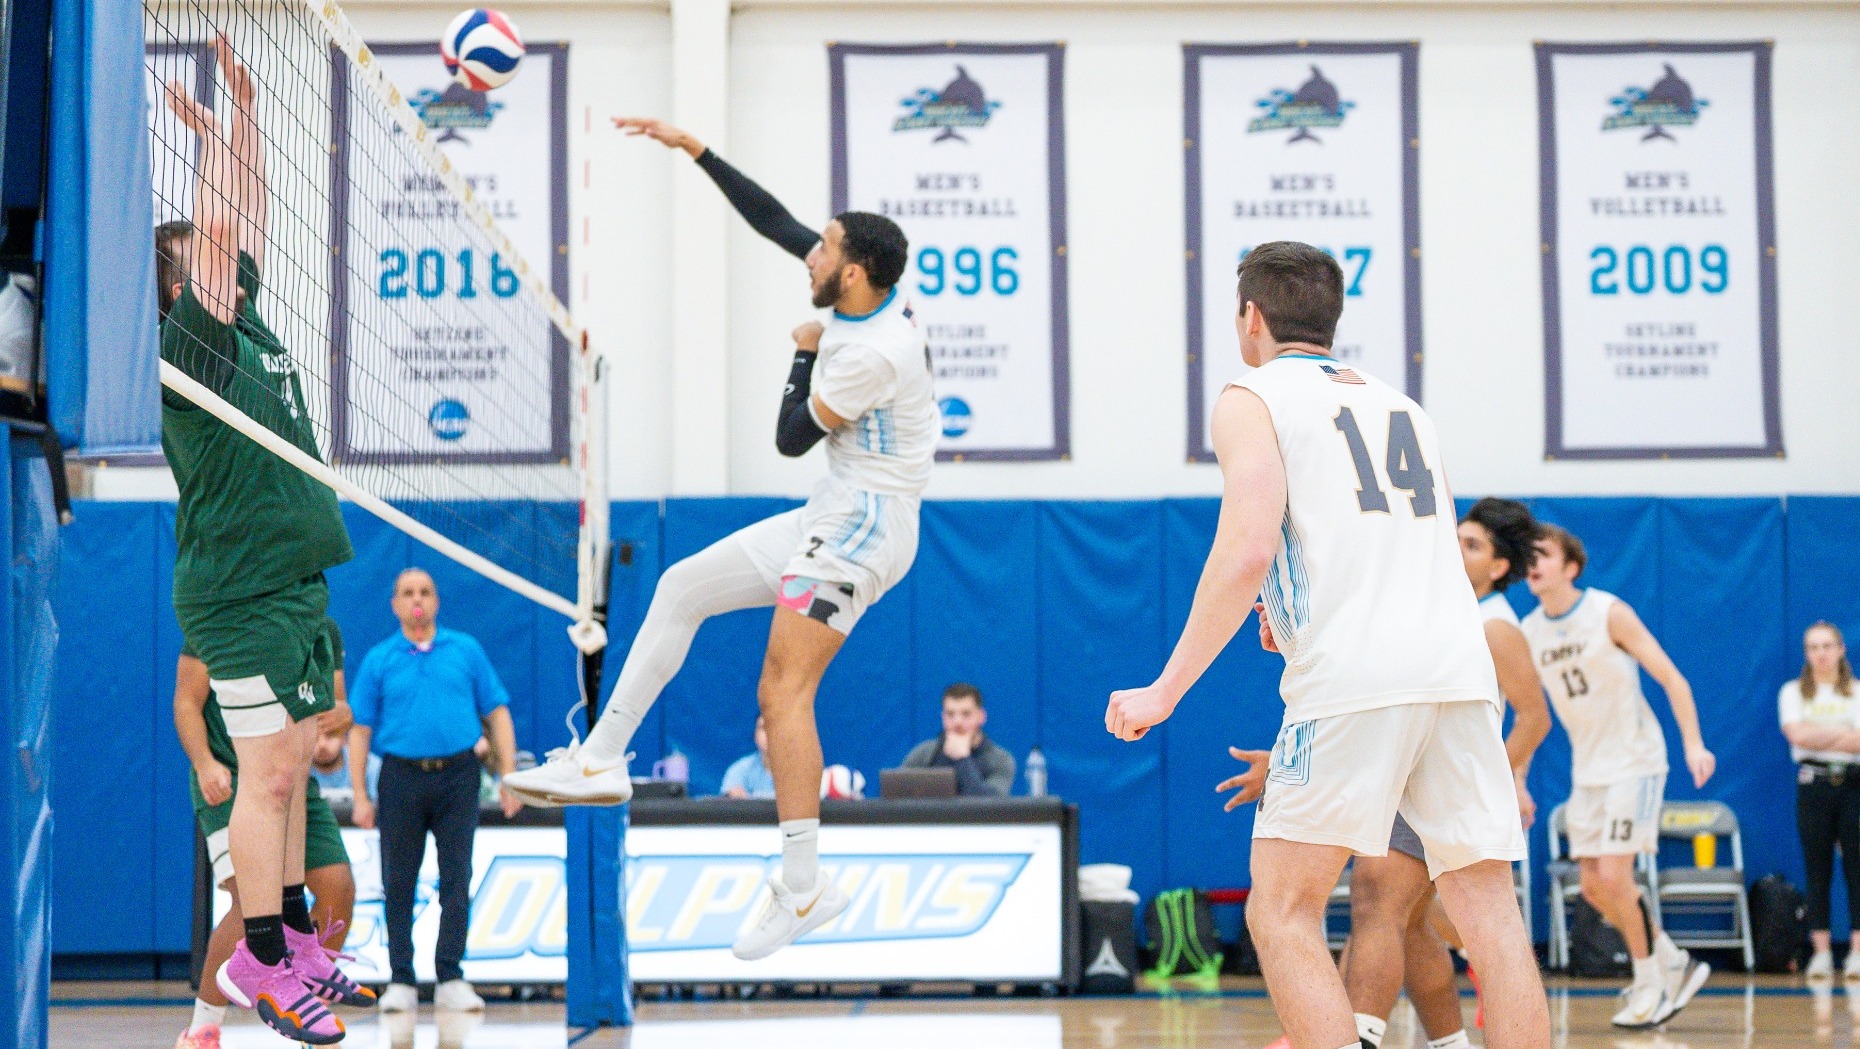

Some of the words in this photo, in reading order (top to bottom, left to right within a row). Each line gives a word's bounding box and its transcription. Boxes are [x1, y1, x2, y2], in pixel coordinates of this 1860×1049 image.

[916, 174, 979, 190] MEN'S
[1271, 174, 1335, 191] MEN'S
[1625, 172, 1689, 189] MEN'S
[881, 198, 1016, 216] BASKETBALL
[1234, 199, 1371, 217] BASKETBALL
[1590, 197, 1726, 215] VOLLEYBALL
[917, 247, 1019, 296] 996
[1590, 245, 1728, 294] 2009
[1331, 404, 1437, 519] 14
[1561, 667, 1589, 698] 13
[1609, 817, 1633, 841] 13
[467, 861, 1013, 949] DLPINS
